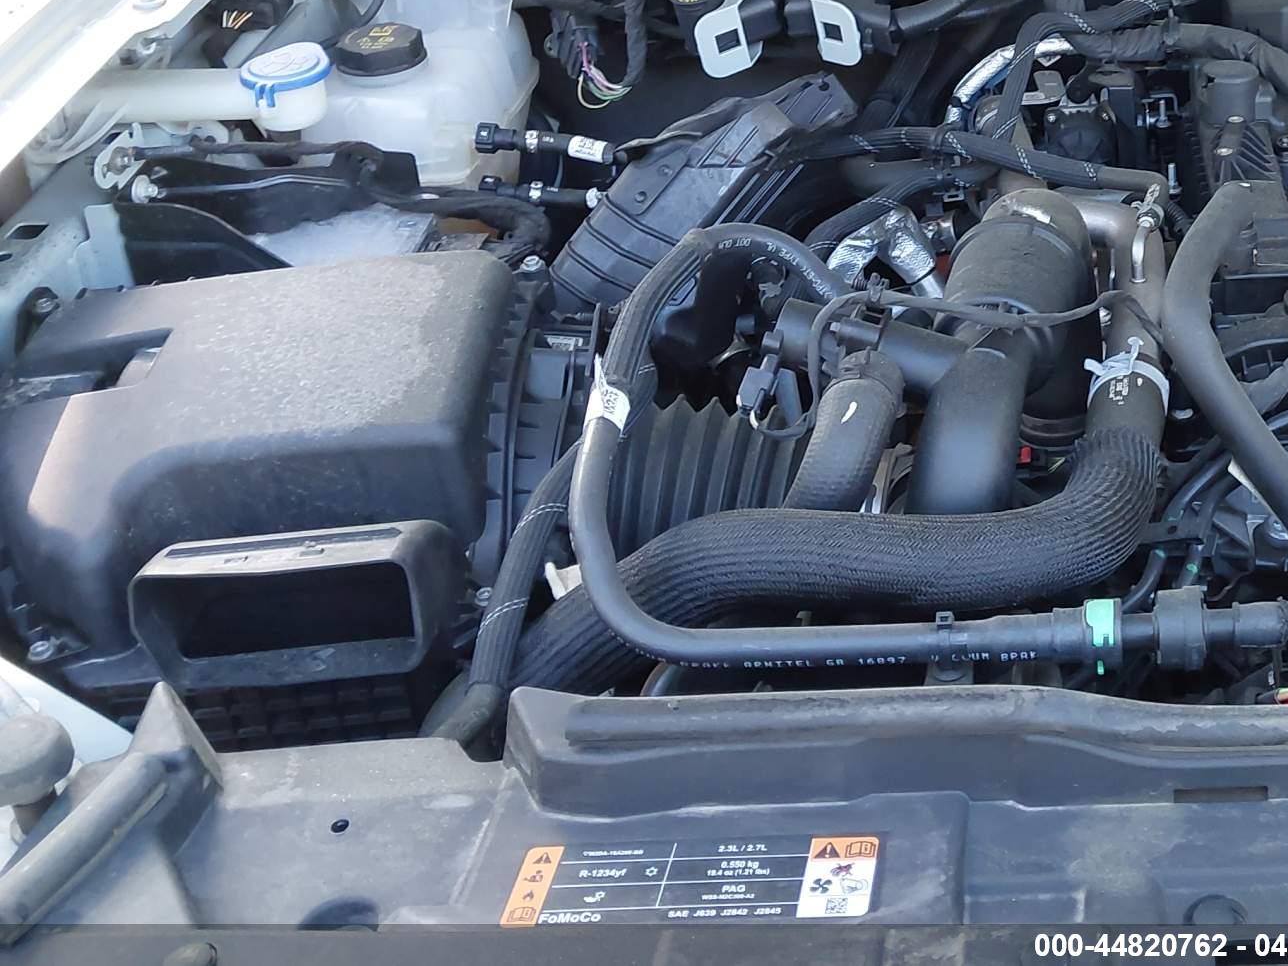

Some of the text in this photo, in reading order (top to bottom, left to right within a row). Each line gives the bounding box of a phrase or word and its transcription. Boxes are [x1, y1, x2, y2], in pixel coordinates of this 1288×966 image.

[717, 845, 739, 853] 2.3L
[746, 844, 768, 852] 2.7L
[720, 860, 760, 870] 0.550 kg
[578, 868, 628, 878] R-1234yf
[721, 884, 746, 894] PAG
[537, 911, 602, 924] FoMoCo
[667, 909, 690, 919] SAE
